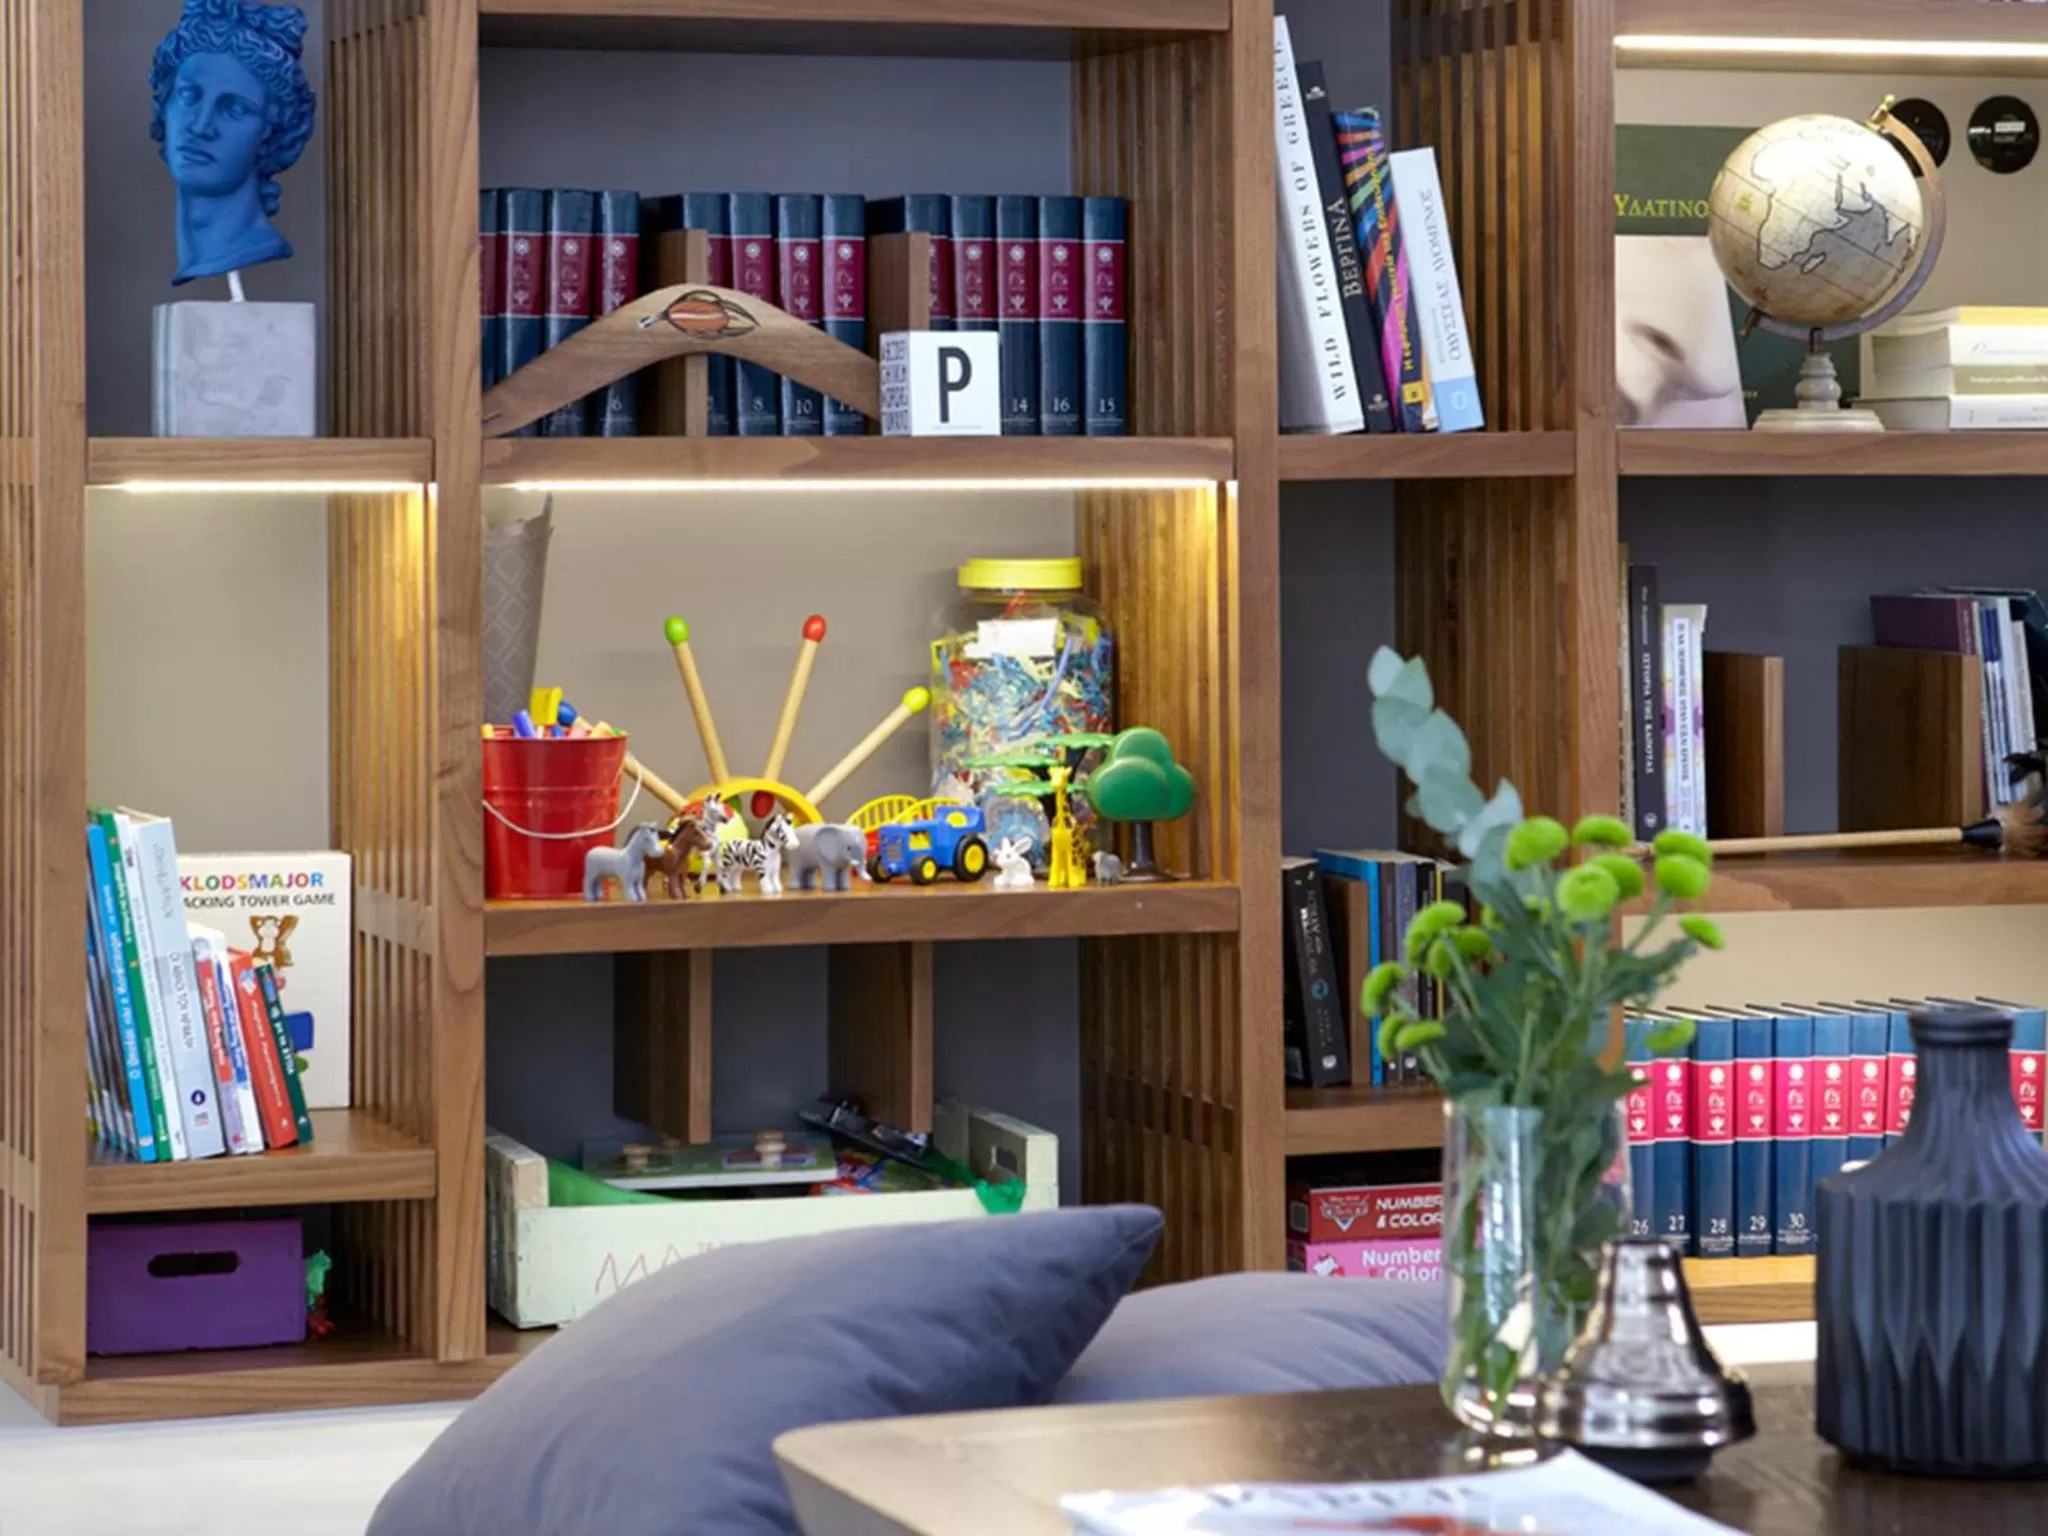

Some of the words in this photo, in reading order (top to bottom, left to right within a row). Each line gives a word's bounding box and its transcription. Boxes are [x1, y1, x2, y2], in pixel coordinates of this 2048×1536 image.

[1290, 160, 1308, 192] OF
[1299, 203, 1333, 321] FLOWERS
[1324, 336, 1347, 402] WILD
[938, 346, 972, 424] P
[796, 398, 813, 415] 10
[1012, 397, 1029, 413] 14
[1053, 396, 1070, 413] 16
[1099, 398, 1115, 414] 15
[180, 872, 323, 891] KLODSMAJOR
[239, 894, 290, 907] TOWER
[293, 893, 336, 906] GAME
[1632, 1219, 1649, 1235] 26
[1668, 1214, 1686, 1231] 27
[1711, 1218, 1728, 1234] 28
[1750, 1215, 1767, 1231] 29
[1788, 1212, 1805, 1229] 30
